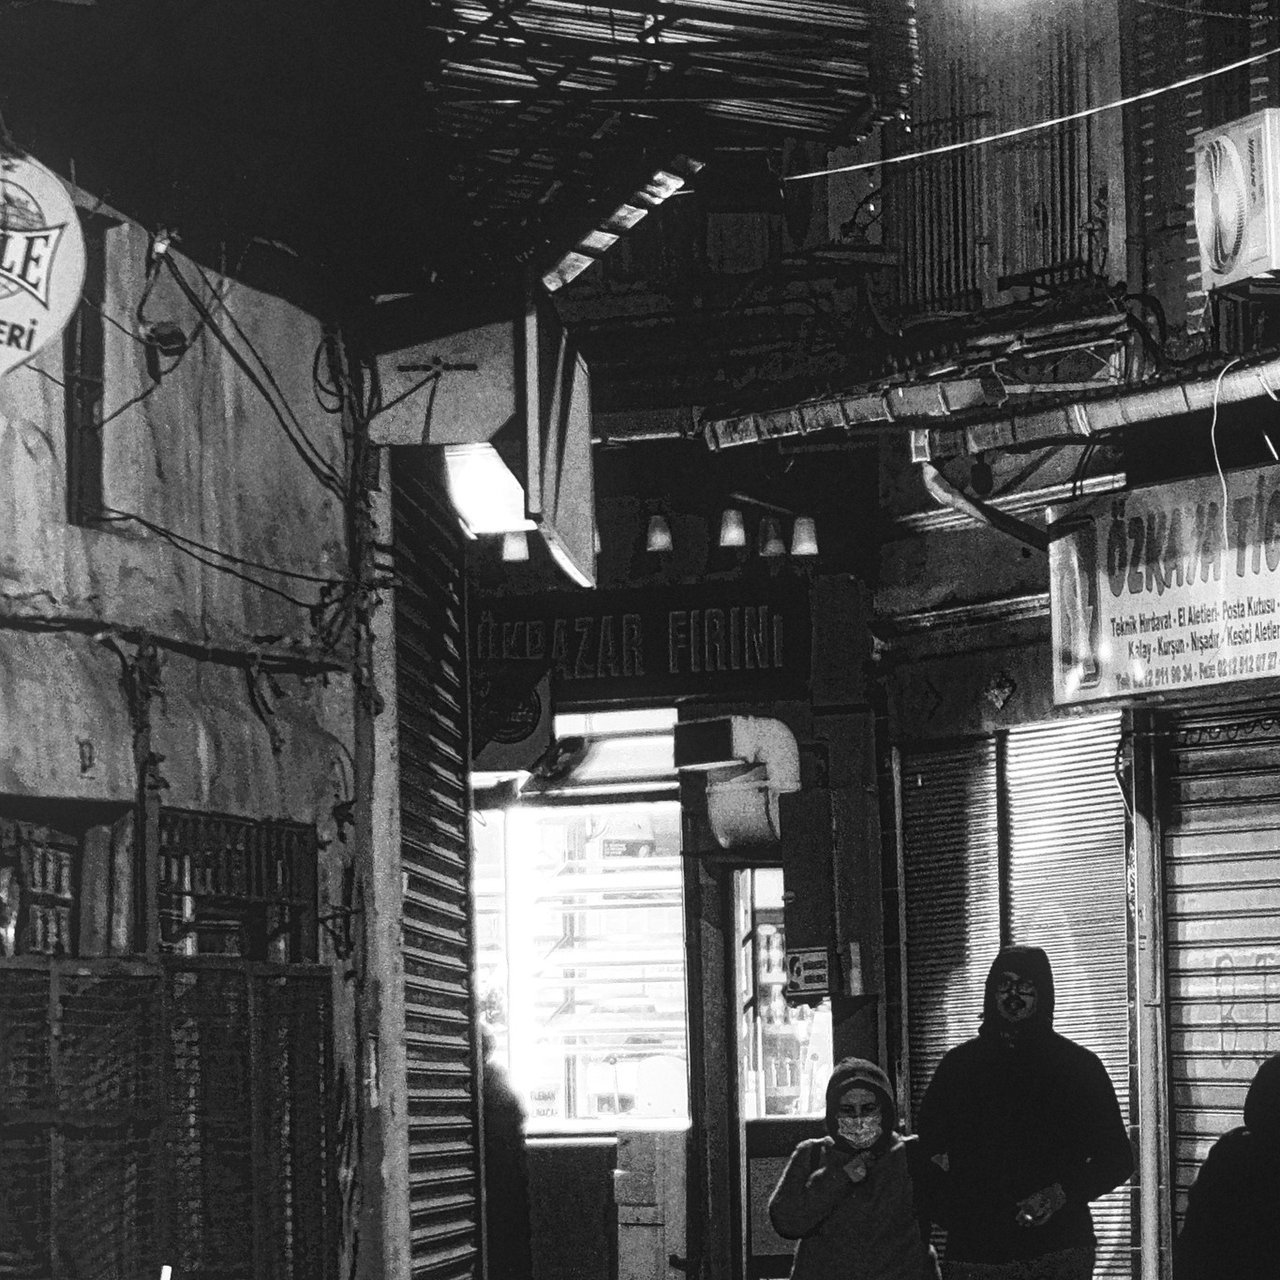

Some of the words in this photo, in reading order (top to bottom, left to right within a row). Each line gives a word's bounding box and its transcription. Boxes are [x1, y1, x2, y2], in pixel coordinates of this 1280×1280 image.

[1106, 498, 1222, 598] ÖZKAYA
[1177, 606, 1187, 628] El
[1222, 598, 1245, 621] Posta
[1246, 596, 1276, 618] Kutusu
[1226, 623, 1253, 647] Kesici
[1253, 620, 1280, 643] Aletler
[668, 605, 785, 674] FIRINI
